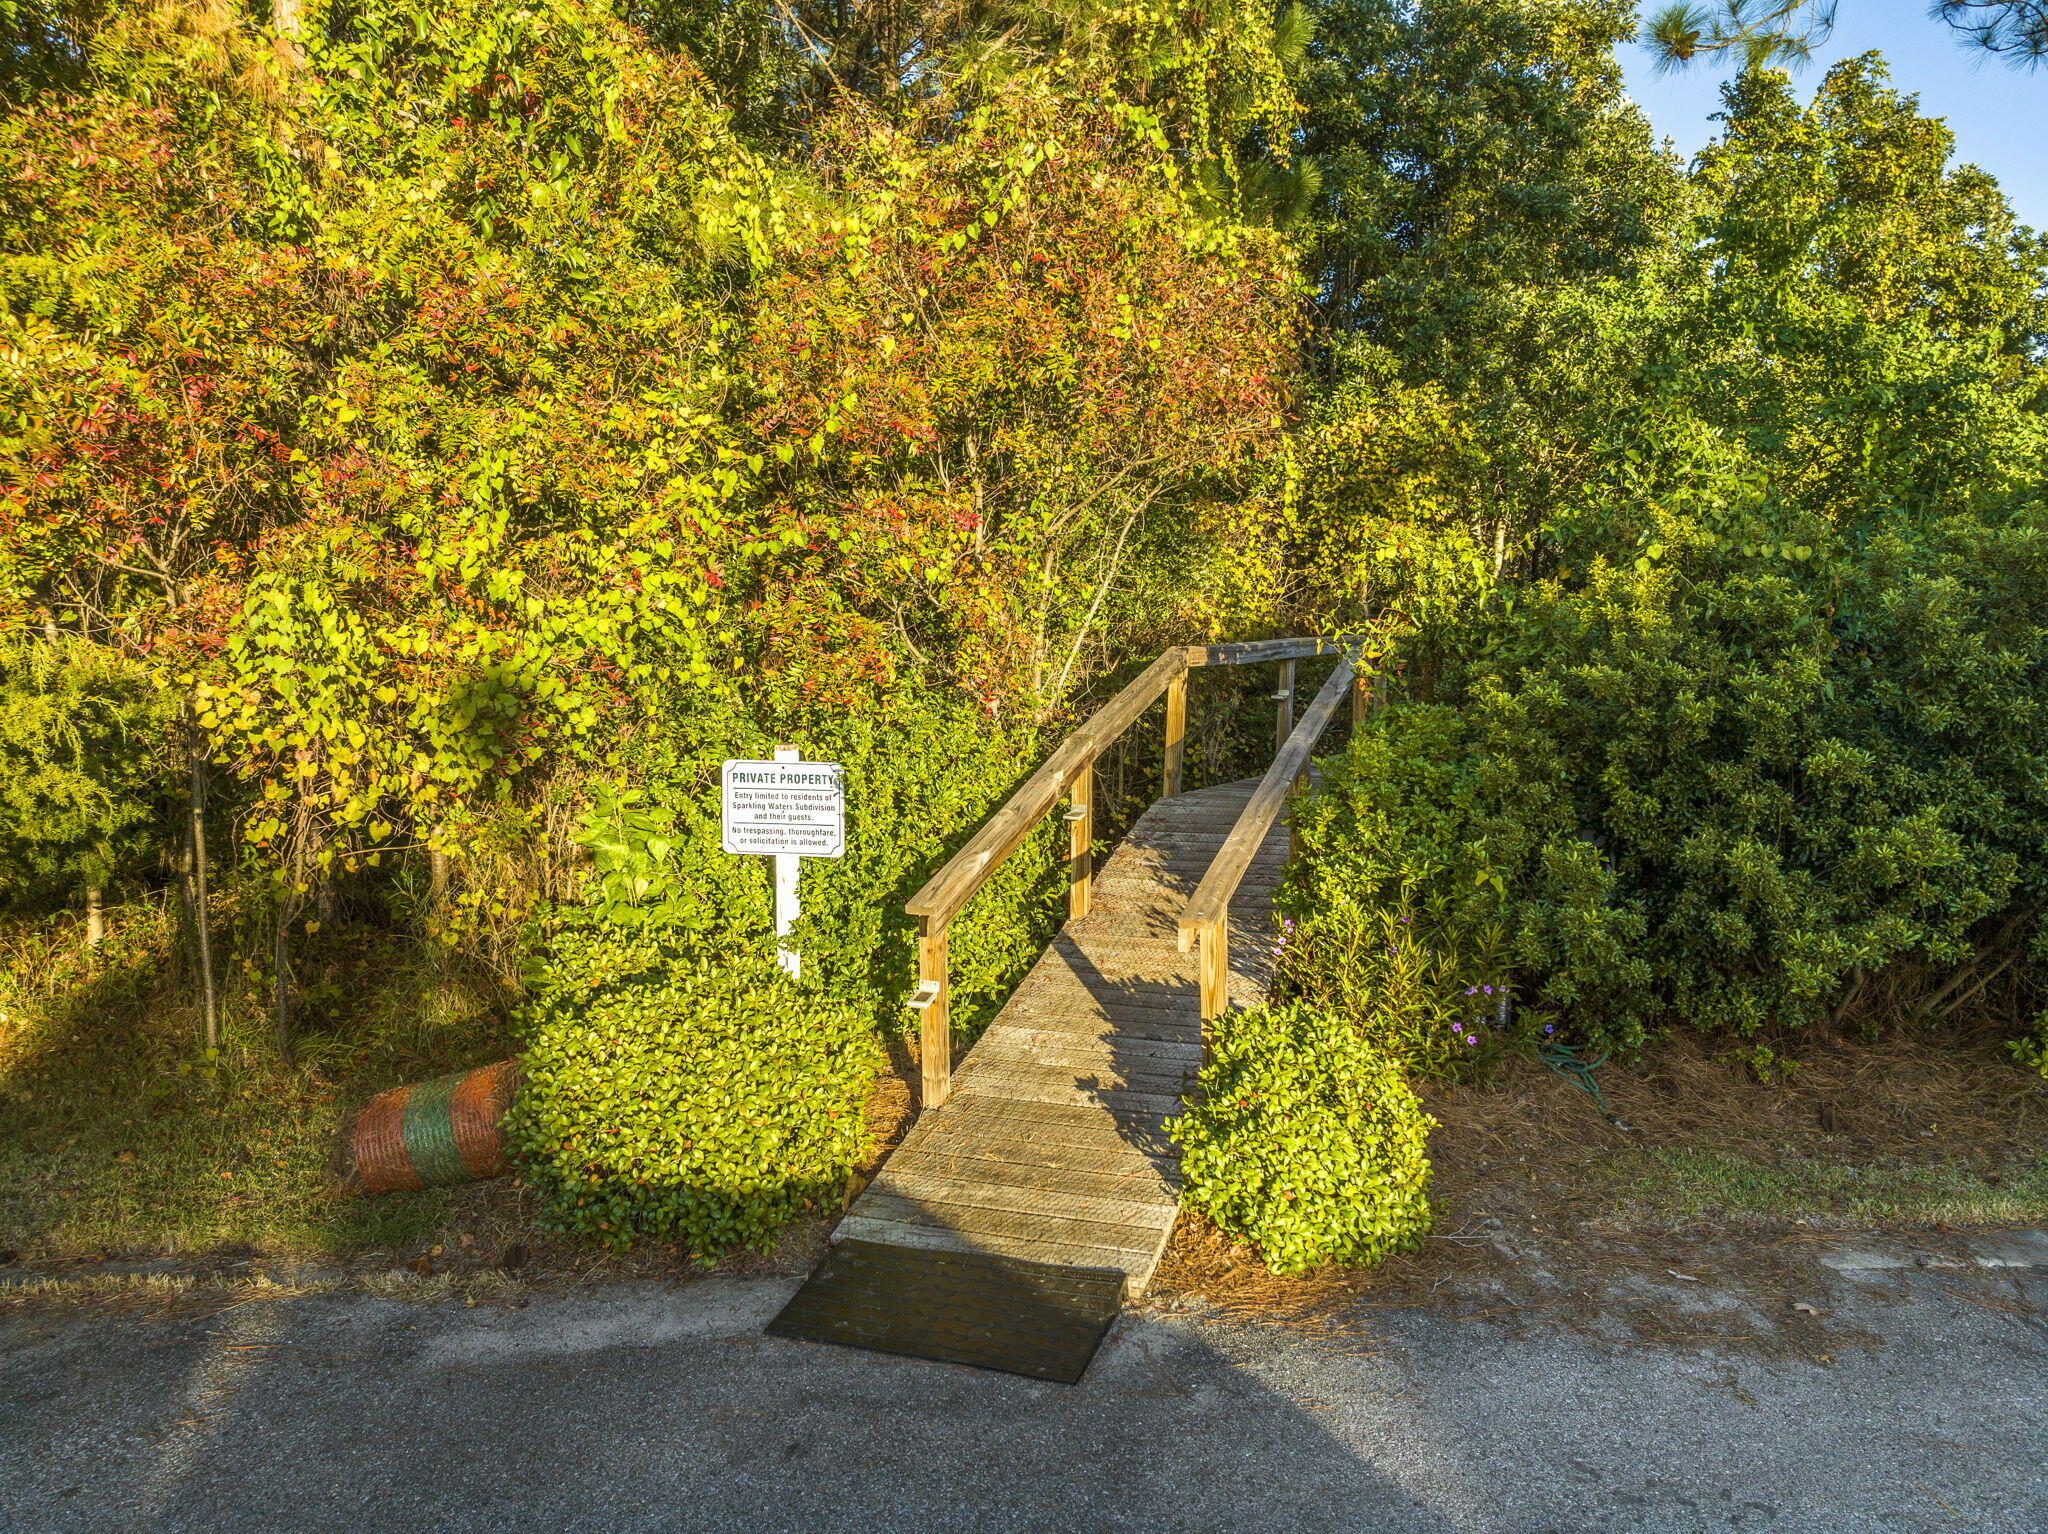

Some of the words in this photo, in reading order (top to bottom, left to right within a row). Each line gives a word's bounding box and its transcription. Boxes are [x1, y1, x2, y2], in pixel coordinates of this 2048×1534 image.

[732, 772, 776, 784] PRIVATE
[780, 773, 834, 785] PROPERTY
[734, 792, 753, 800] Entry
[754, 792, 779, 800] limited
[790, 793, 823, 801] residents
[825, 793, 832, 801] of
[732, 802, 766, 811] Sparkling
[768, 802, 793, 810] Waters
[795, 803, 836, 811] Subdivision
[732, 826, 741, 834] No
[749, 837, 789, 845] solicitation
[799, 838, 829, 846] allowed.
